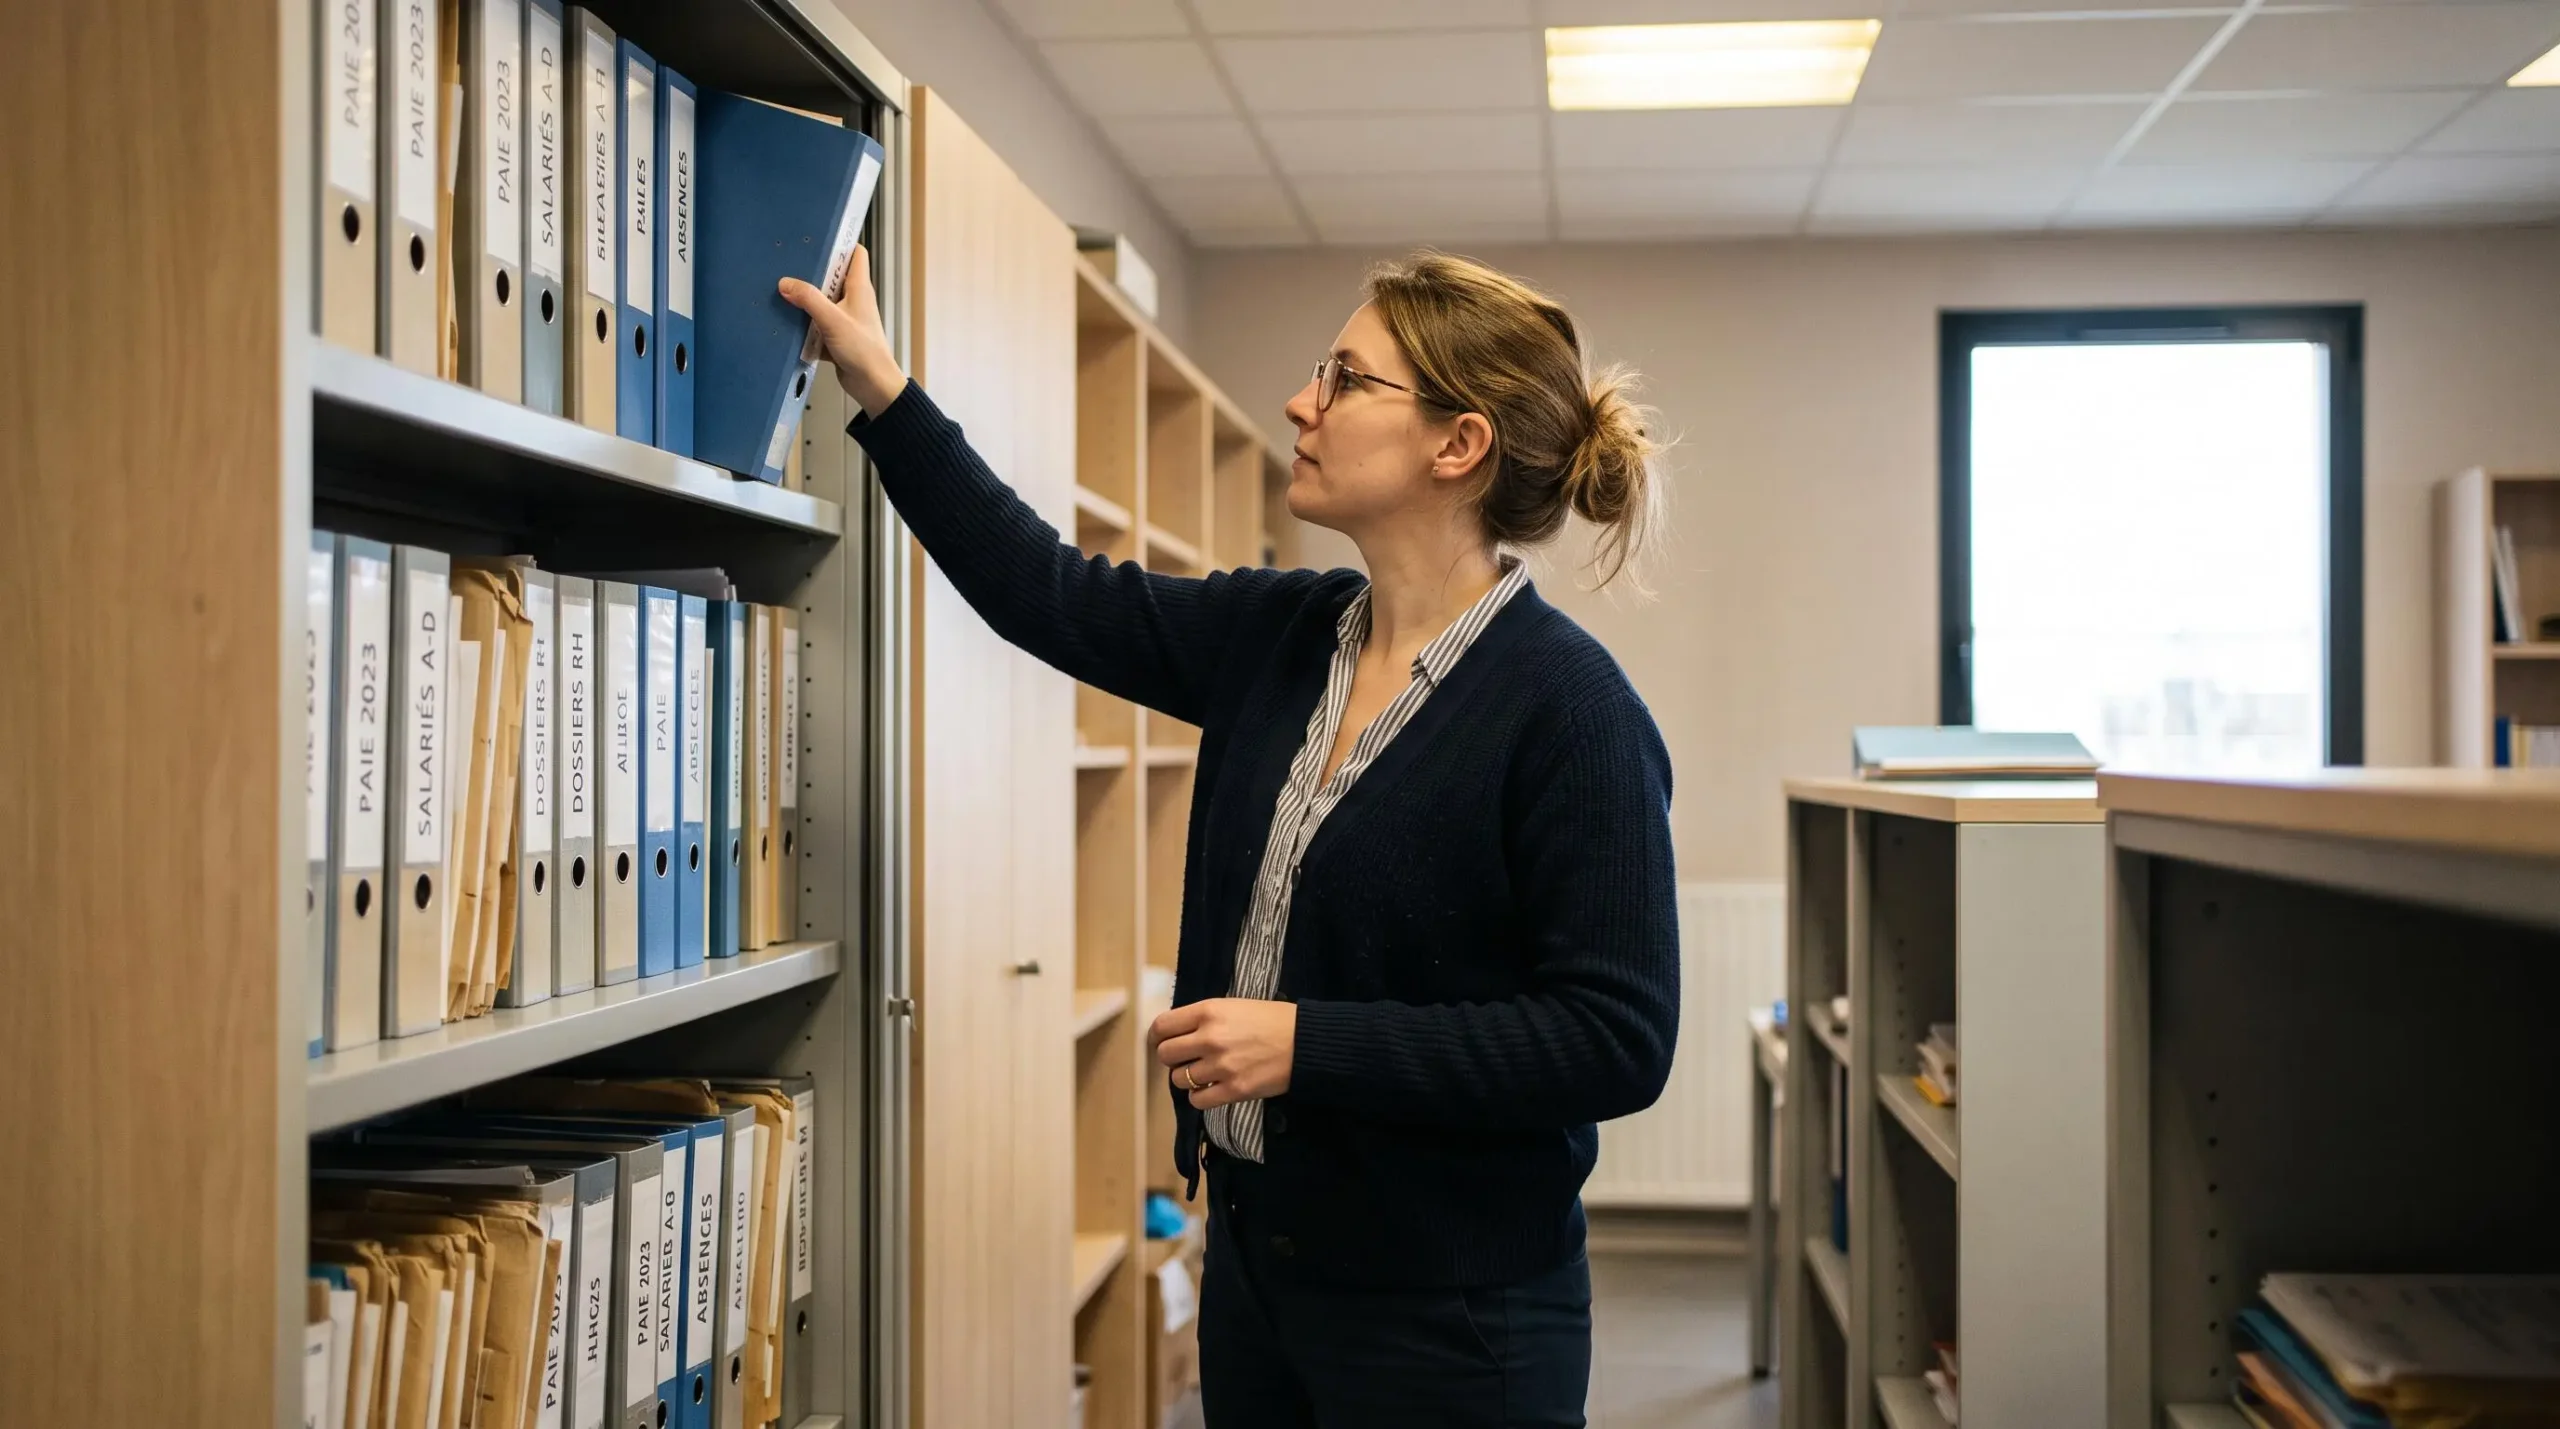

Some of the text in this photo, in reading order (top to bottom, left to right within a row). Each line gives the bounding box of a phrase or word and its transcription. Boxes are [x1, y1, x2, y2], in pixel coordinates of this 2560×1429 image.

[344, 0, 361, 129] PAIE 20
[409, 89, 425, 158] PAIE
[496, 60, 511, 204] PAIE 2023
[539, 46, 555, 247] SALARIÉS A-D
[677, 149, 689, 263] ABSENCES
[358, 641, 377, 814] PAIE 2023
[415, 611, 437, 837] SALARIÉS A-D
[535, 678, 545, 816] DOSSIERS
[571, 632, 584, 814] DOSSIERS RH
[655, 693, 667, 751] PAIE
[637, 1240, 651, 1346] PAIE 2023
[696, 1192, 713, 1324] ABSENCES
[546, 1345, 559, 1410] PAIE
